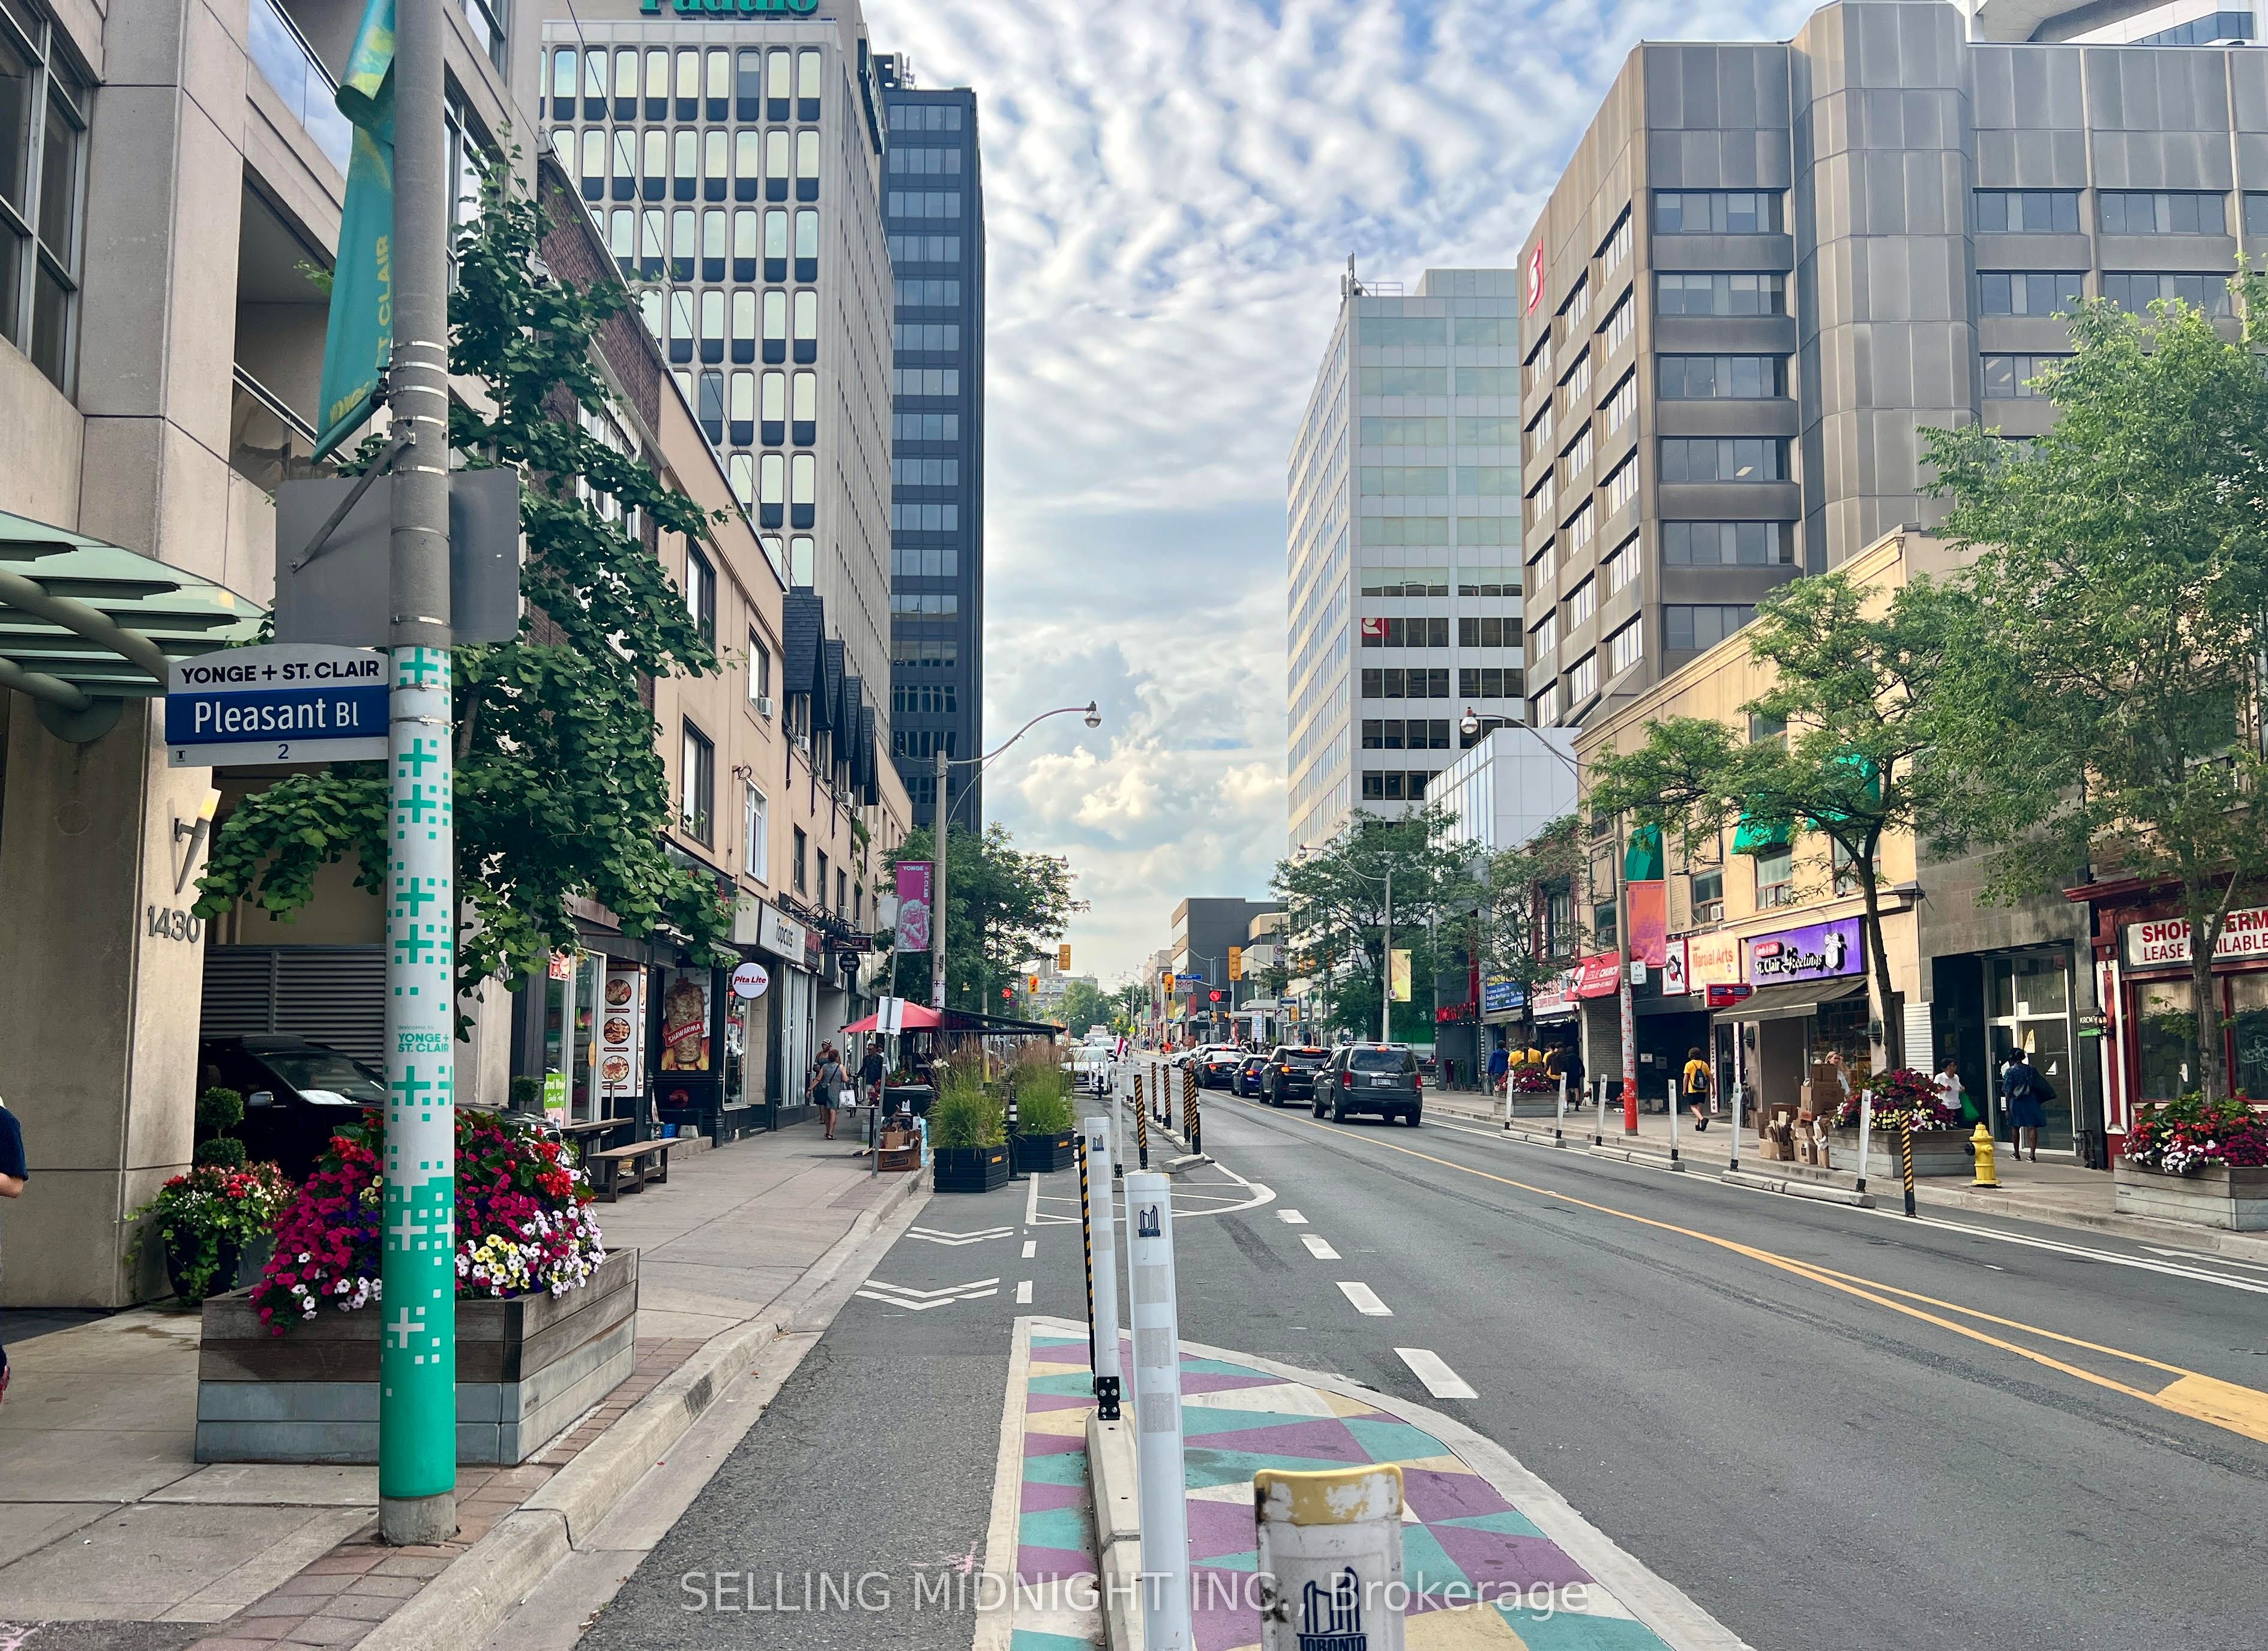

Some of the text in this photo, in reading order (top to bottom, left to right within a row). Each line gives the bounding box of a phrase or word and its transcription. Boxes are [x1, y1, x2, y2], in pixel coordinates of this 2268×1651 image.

[376, 236, 391, 325] CLAIR
[181, 665, 257, 684] YONGE
[282, 663, 310, 680] ST.
[314, 660, 380, 678] CLAIR
[194, 698, 359, 733] Pleasant Bl
[277, 744, 289, 760] 2
[148, 905, 201, 943] 1430
[2225, 909, 2268, 933] ERM
[1693, 948, 1733, 968] Martial Arts
[1754, 946, 1822, 973] St. Clair Greetings
[2144, 943, 2184, 961] LEASE
[733, 975, 766, 985] Pita Lite
[1599, 965, 1619, 978] CHURCH
[398, 1033, 441, 1042] YONGE
[668, 1023, 701, 1043] SHAWARMA
[397, 1043, 449, 1053] ST. CLAIR
